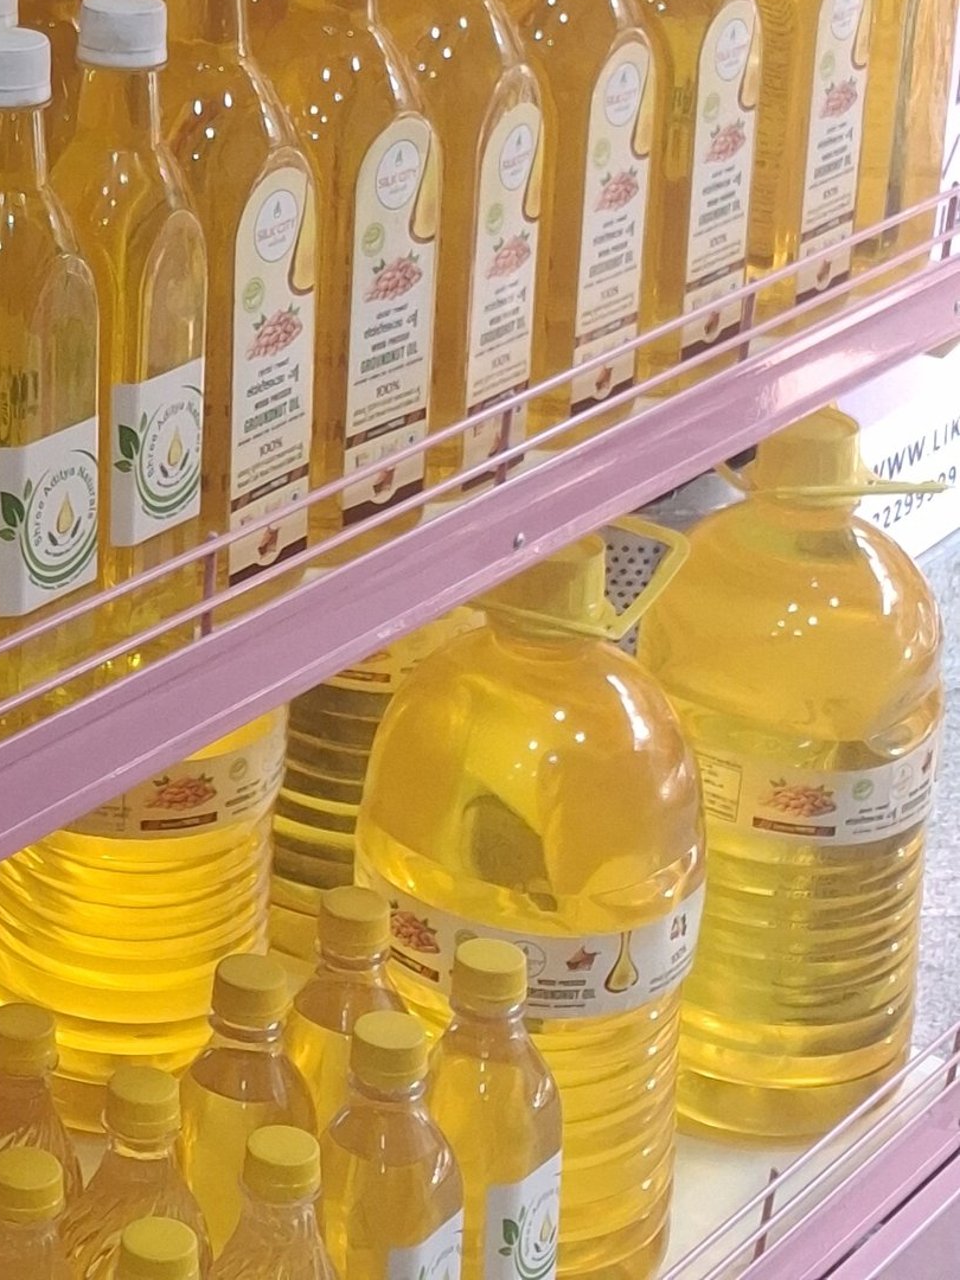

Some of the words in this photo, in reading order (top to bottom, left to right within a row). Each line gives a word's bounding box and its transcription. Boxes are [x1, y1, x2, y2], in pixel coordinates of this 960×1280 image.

[376, 379, 401, 399] 100%
[33, 500, 45, 548] Shree
[43, 466, 77, 498] Aditya
